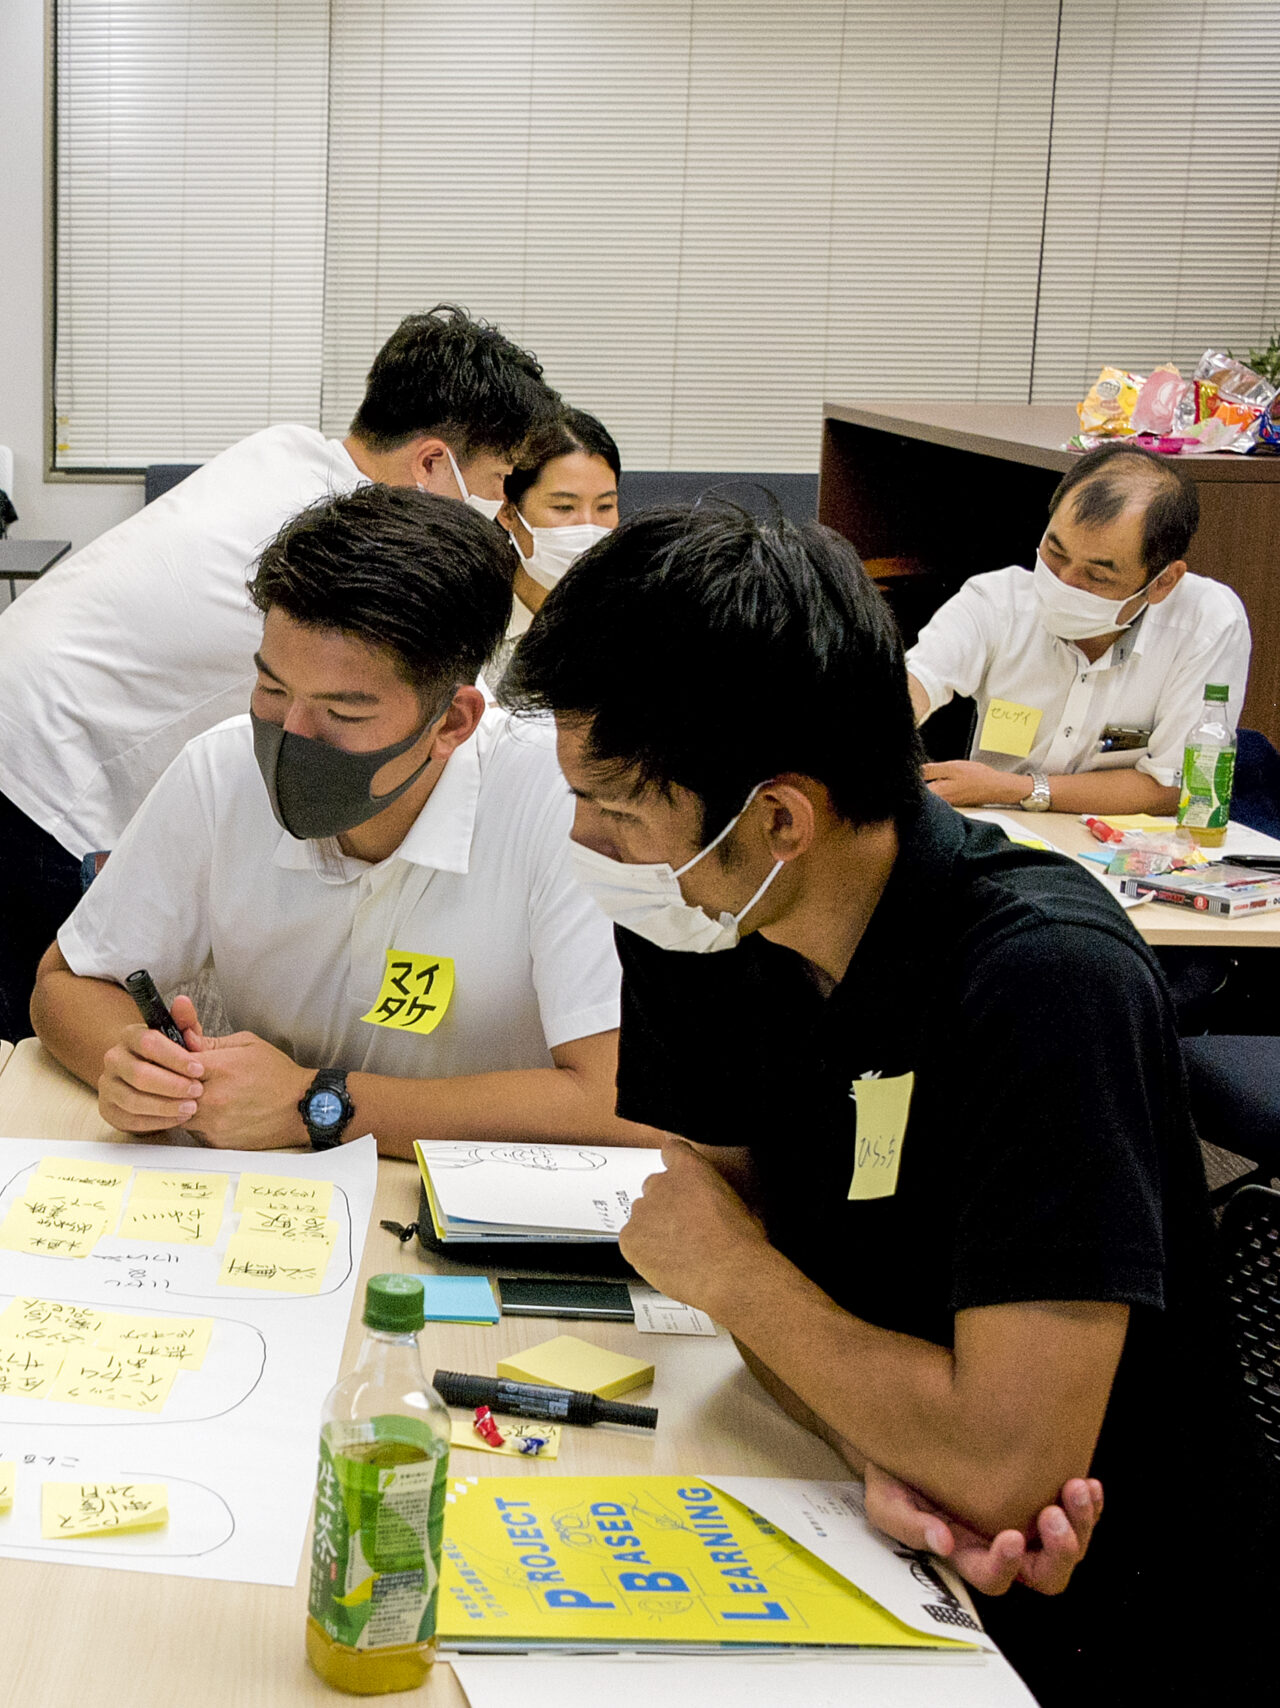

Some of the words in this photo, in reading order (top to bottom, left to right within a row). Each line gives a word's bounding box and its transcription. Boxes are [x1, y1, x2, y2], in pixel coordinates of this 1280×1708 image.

[375, 996, 437, 1027] タケ
[390, 962, 440, 996] マイ
[316, 1460, 339, 1564] 生茶
[494, 1497, 616, 1609] PROJECT
[589, 1502, 691, 1593] BASED
[676, 1487, 791, 1621] LEARNING
